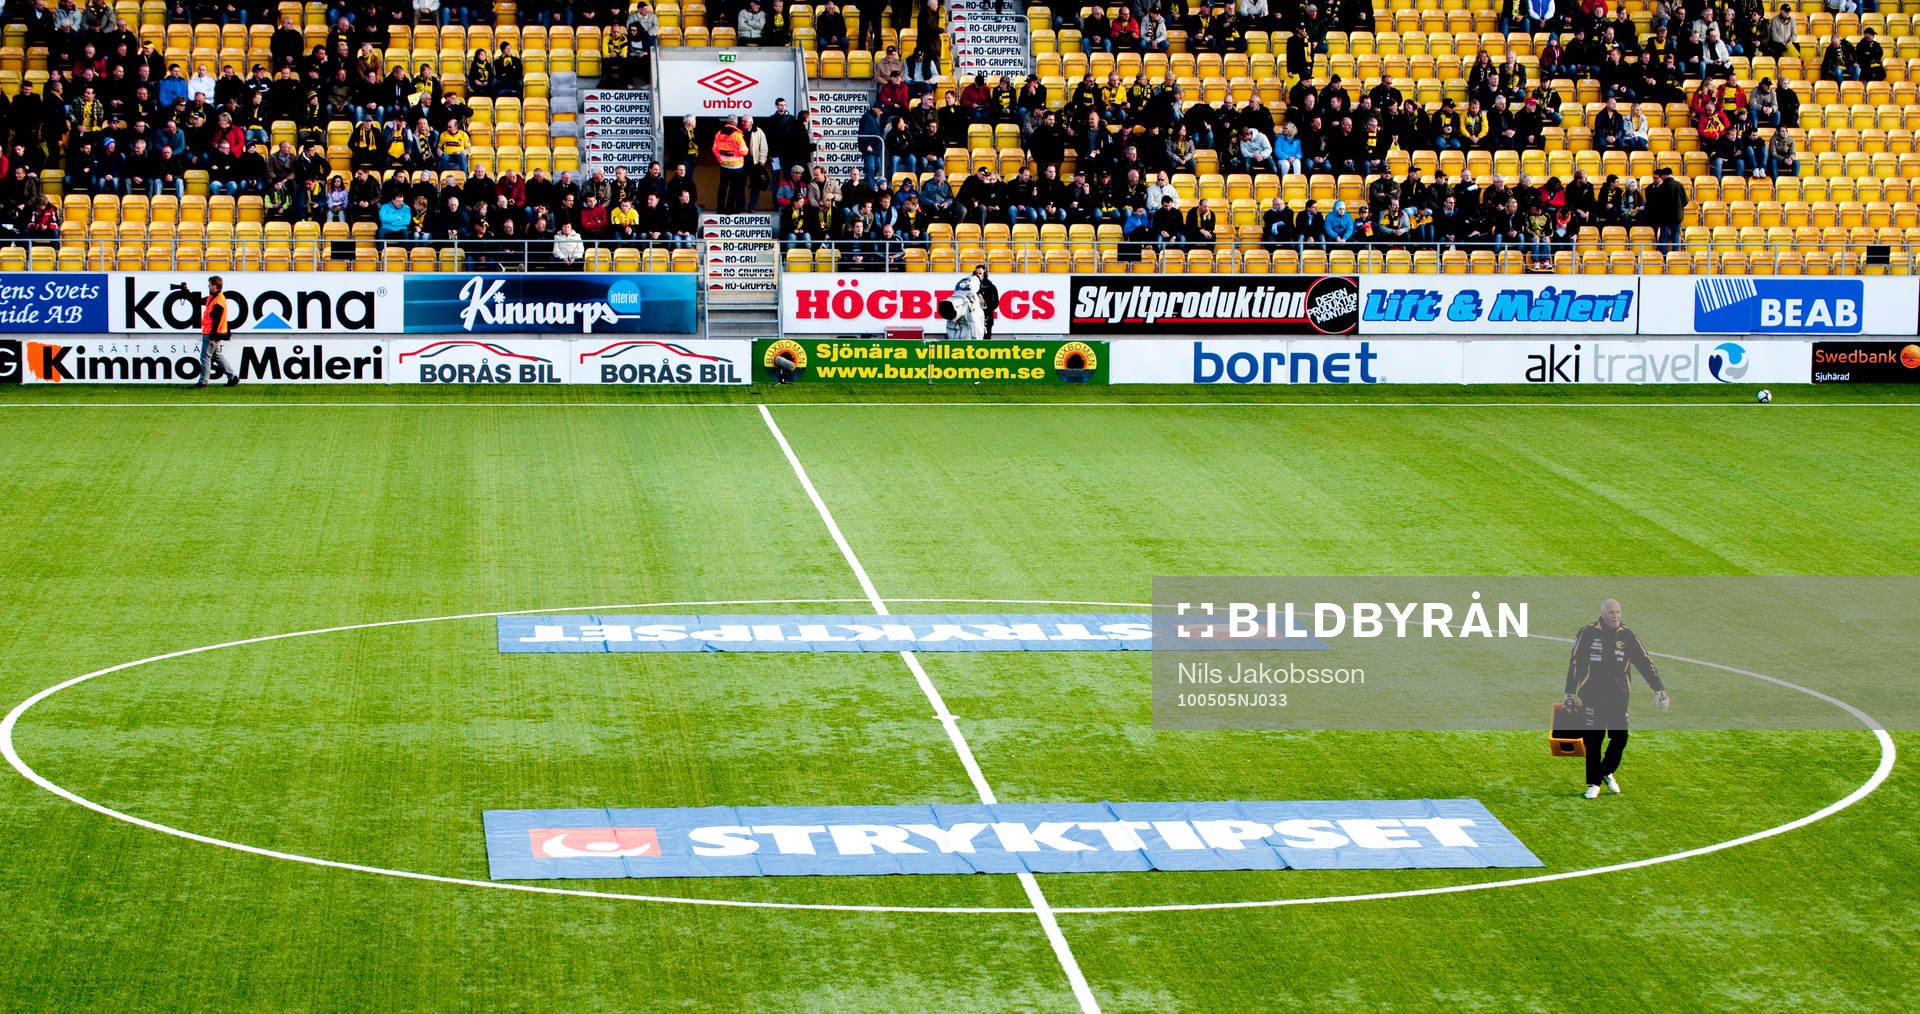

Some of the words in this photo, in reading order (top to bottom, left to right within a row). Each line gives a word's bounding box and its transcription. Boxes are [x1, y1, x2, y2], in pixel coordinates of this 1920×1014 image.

[970, 24, 1016, 32] RO-GRUPPEN
[974, 47, 1021, 55] RO-GRUPPEN
[976, 58, 1023, 66] RO-GRUPPEN
[600, 92, 649, 100] RO-GRUPPEN
[703, 97, 752, 109] umbro
[819, 93, 868, 101] RO-GRUPPEN
[601, 104, 650, 112] RO-GRUPPEN
[601, 116, 650, 124] RO-GRUPPEN
[601, 141, 651, 149] RO-GRUPPEN
[603, 153, 653, 161] RO-GRUPPEN
[719, 216, 770, 225] RO-GRUPPEN
[720, 229, 771, 238] RO-GRUPPEN
[723, 243, 774, 251] RO-GRUPPEN
[0, 283, 35, 301] ens
[39, 281, 100, 300] Svets
[610, 289, 639, 304] interior
[796, 279, 1055, 320] HÖGBGS
[1315, 288, 1348, 306] DESIGN
[459, 276, 640, 333] Kinnarps
[1074, 285, 1306, 324] Skyltproduktion
[1316, 302, 1357, 324] MONTAGE
[1363, 289, 1442, 322] Lift
[1447, 289, 1482, 321] &
[1488, 286, 1633, 322] Måleri
[1760, 298, 1858, 327] BEAB
[44, 305, 83, 323] AB
[98, 343, 141, 353] RÄTT
[152, 344, 159, 353] &
[766, 341, 806, 364] BUXBOMEN
[816, 343, 911, 361] Sjönära
[915, 343, 1045, 360] villatomter
[1056, 343, 1096, 366] BUXBOMEN
[1815, 349, 1897, 364] Swedbank
[239, 344, 382, 380] Måleri
[420, 358, 511, 383] BORÅS
[519, 364, 561, 383] BIL
[601, 358, 692, 383] BORÅS
[700, 364, 742, 383] BIL
[1193, 342, 1377, 384] bornet
[1525, 343, 1581, 383] aki
[1593, 343, 1699, 383] travel
[816, 364, 1045, 380] www.buxbomen.se
[1815, 371, 1850, 383] Sjuhärad
[520, 623, 1154, 642] STRYKTIPSET
[688, 818, 1480, 857] STRYKTIPSET
